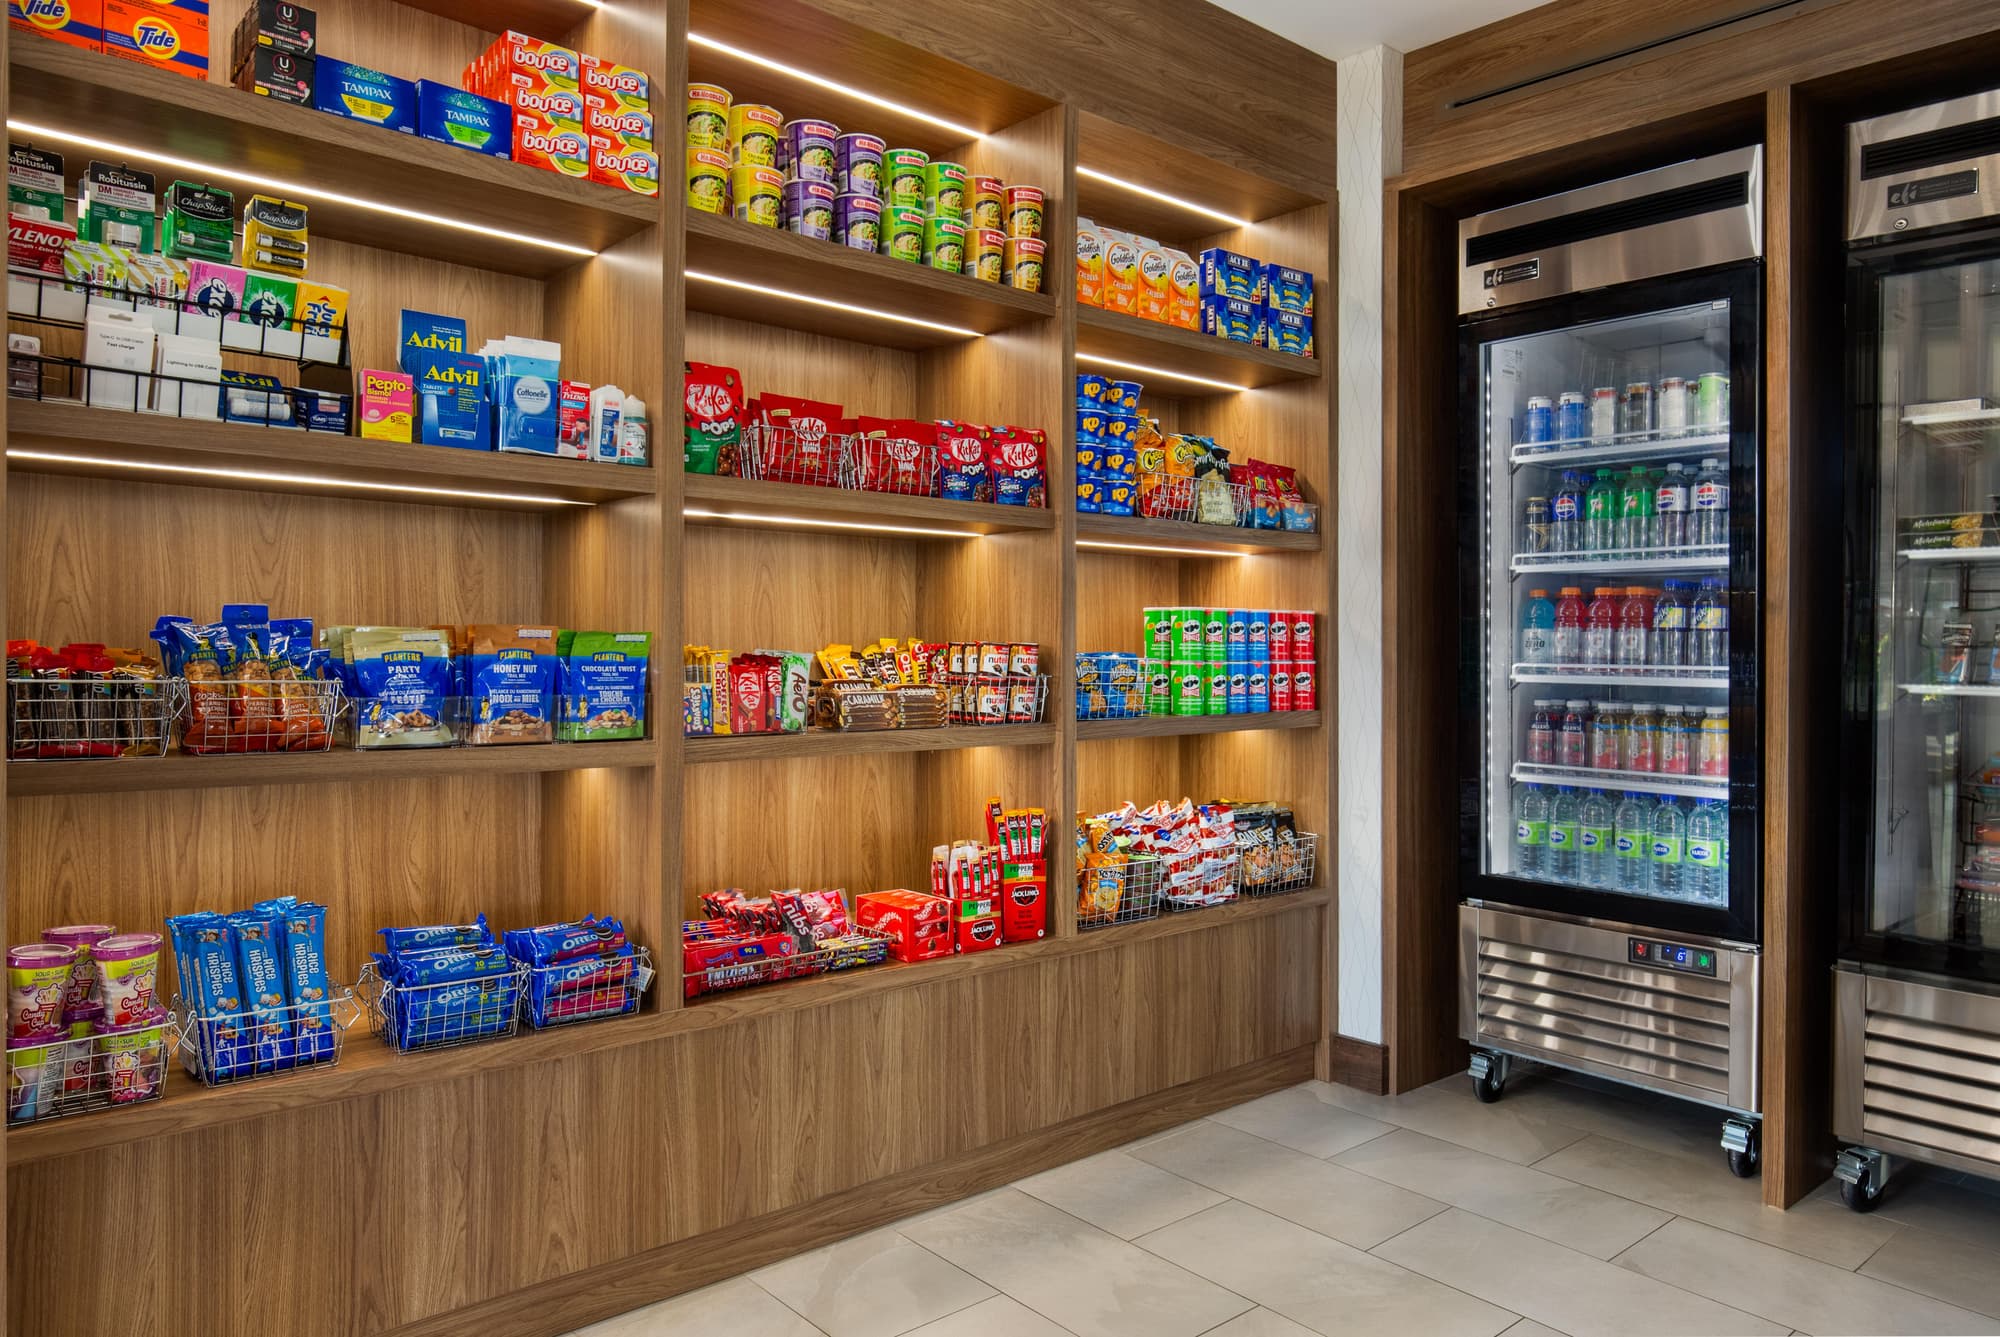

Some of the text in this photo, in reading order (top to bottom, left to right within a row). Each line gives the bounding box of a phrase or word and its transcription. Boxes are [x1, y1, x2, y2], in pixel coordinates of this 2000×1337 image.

[138, 25, 176, 48] Tide
[514, 45, 568, 70] bounce
[587, 69, 638, 90] bounce
[342, 81, 392, 100] TAMPAX
[518, 89, 573, 112] bounce
[445, 110, 490, 127] TAMPAX
[592, 110, 643, 132] bounce
[523, 130, 579, 154] bounce
[597, 151, 648, 172] bounce
[98, 173, 147, 191] Robitussin
[98, 184, 112, 195] DM
[181, 197, 225, 214] ChapStick
[258, 211, 299, 226] ChapStick
[8, 226, 66, 249] YLENO
[1110, 252, 1135, 265] Goldfish
[1143, 261, 1167, 274] Goldfish
[1175, 271, 1197, 282] Goldfish
[406, 331, 462, 353] Advil
[367, 375, 411, 393] Pepto-
[424, 365, 479, 387] Advil
[366, 387, 392, 398] Bismol
[694, 385, 729, 415] KitKat
[701, 418, 736, 435] POPS
[957, 438, 980, 461] KitKat
[1007, 444, 1037, 467] KitKat
[962, 462, 985, 476] POPS
[384, 652, 421, 663] PLANTERS
[500, 650, 532, 661] PLANTERS
[594, 653, 624, 663] PLANTERS
[387, 665, 421, 674] PARTY
[493, 664, 538, 674] HONEY NUT
[581, 665, 636, 673] CHOCOLATE TWIST
[720, 670, 728, 712] COFFEE
[740, 675, 760, 710] KitKat
[791, 671, 807, 713] Aero
[834, 682, 872, 691] CARAMILK
[522, 694, 540, 703] MIEL
[847, 693, 884, 706] CARAMILK
[690, 687, 701, 731] SMARTIES
[1011, 890, 1025, 898] JACK
[783, 903, 809, 936] nibs
[415, 927, 456, 942] OREO
[455, 935, 464, 943] 10
[562, 933, 599, 950] OREO
[744, 947, 753, 955] 90
[263, 958, 277, 980] RICE
[294, 943, 309, 987] KRISPIES
[307, 952, 319, 974] RICE
[434, 951, 475, 970] OREO
[475, 960, 485, 968] 10
[207, 952, 224, 996] KRISPIES
[220, 960, 234, 984] RICE
[250, 949, 267, 993] KRISPIES
[567, 961, 605, 980] OREO
[122, 997, 144, 1009] Candy
[437, 985, 479, 1004] OREO
[22, 1009, 45, 1021] Candy
[131, 1004, 146, 1017] Cup
[31, 1017, 45, 1030] Cup
